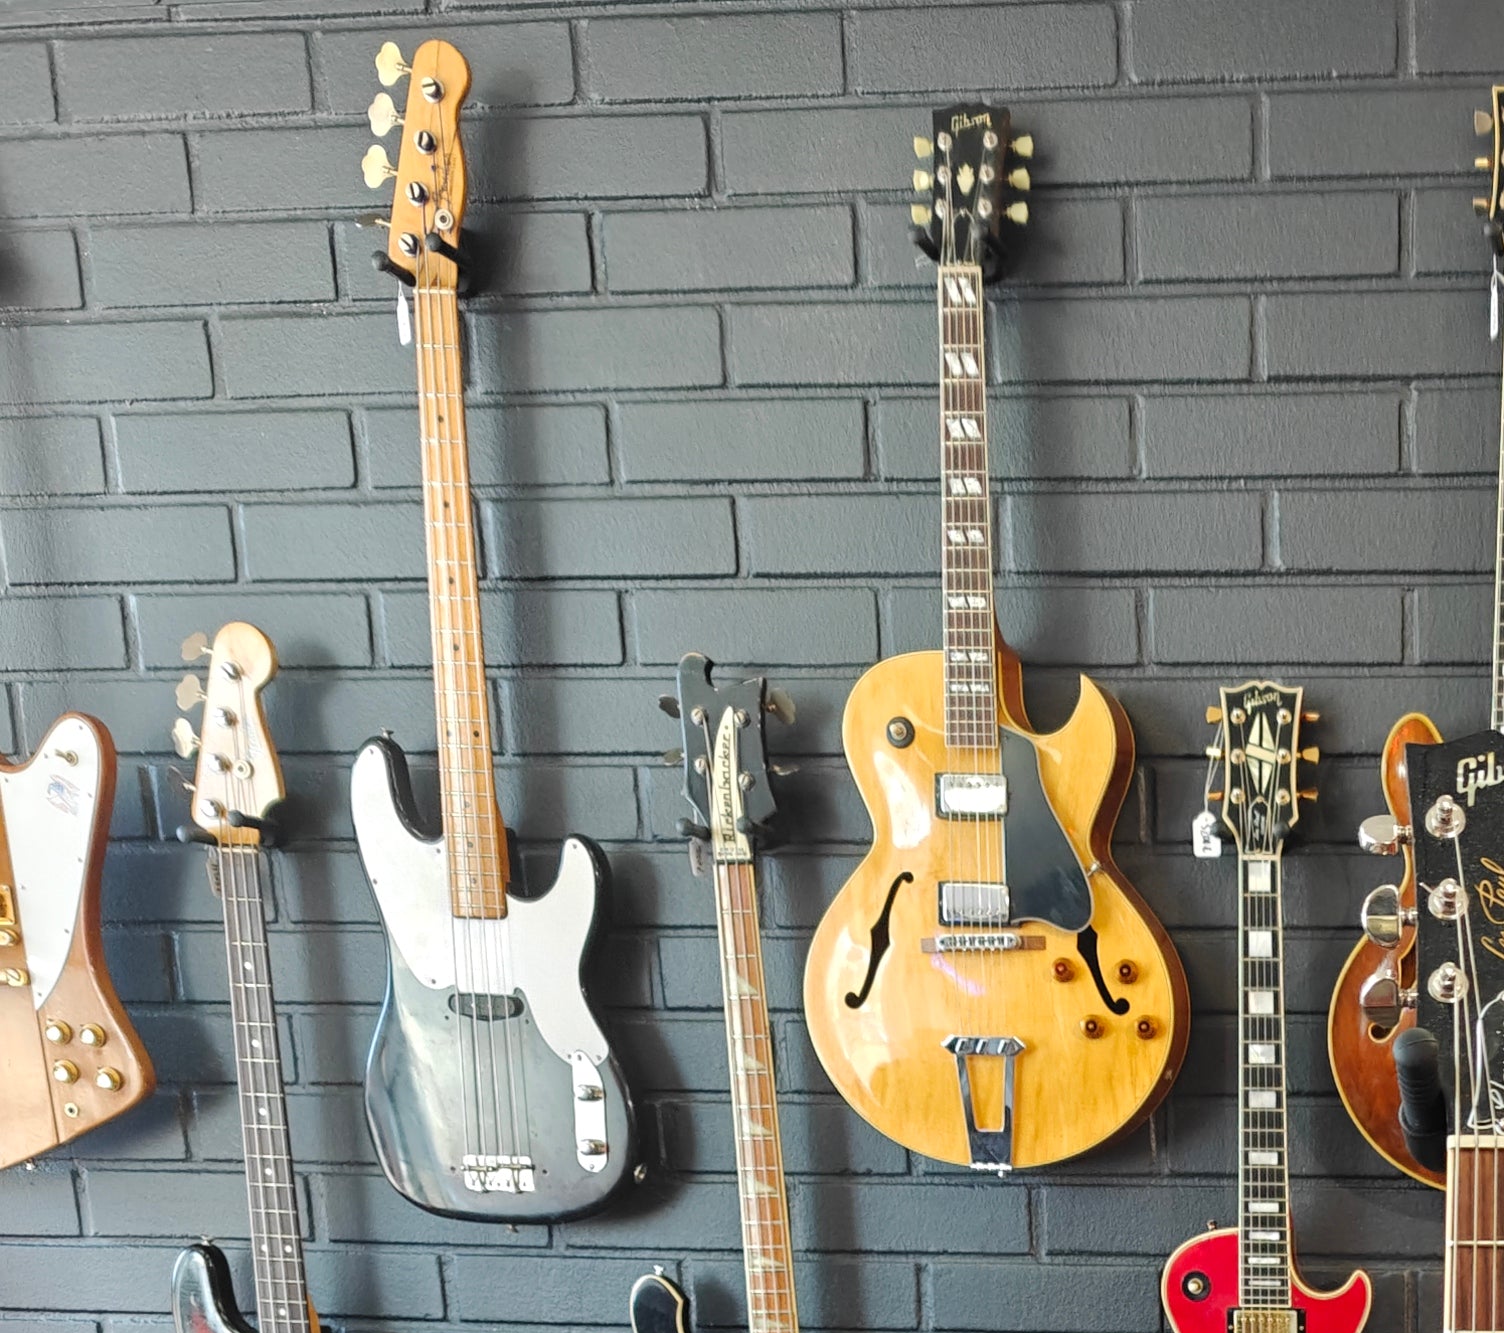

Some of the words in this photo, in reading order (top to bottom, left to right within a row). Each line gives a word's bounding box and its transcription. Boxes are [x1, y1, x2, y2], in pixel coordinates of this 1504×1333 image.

[950, 112, 993, 138] Gibson
[1243, 689, 1283, 716] Gibson
[719, 733, 737, 843] Rickenbacker
